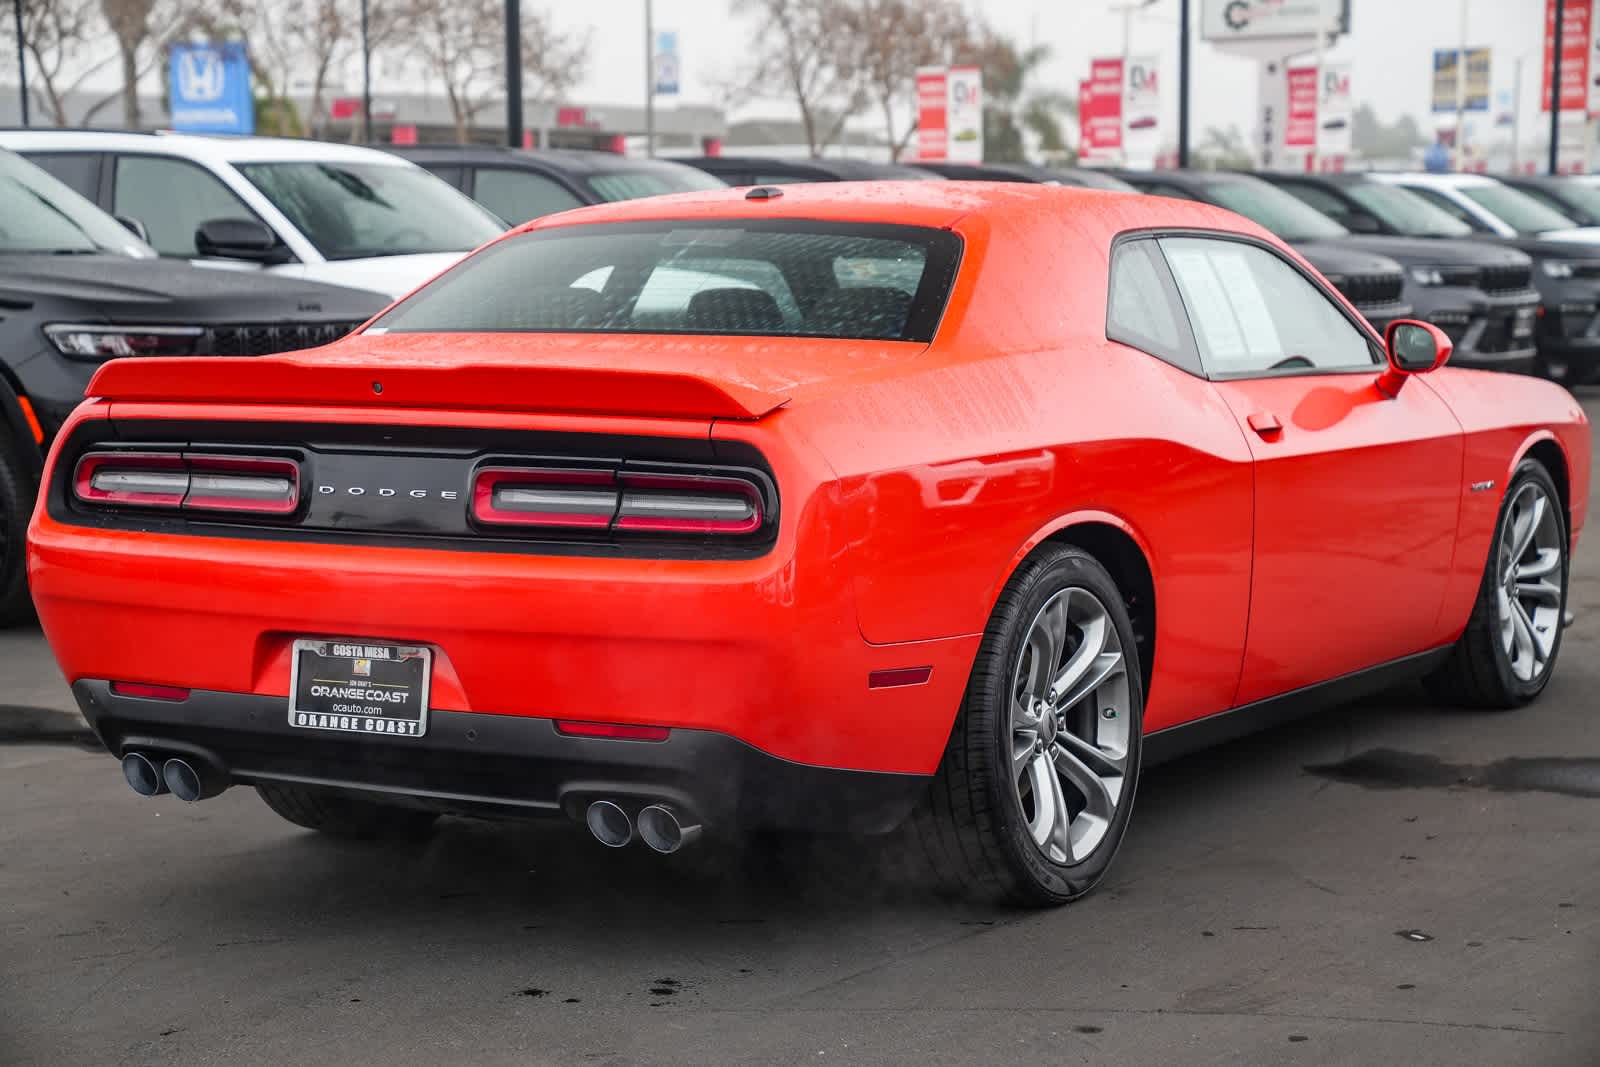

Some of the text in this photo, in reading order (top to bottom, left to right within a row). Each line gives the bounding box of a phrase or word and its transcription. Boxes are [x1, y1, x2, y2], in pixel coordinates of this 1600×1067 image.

[319, 485, 457, 500] DODGE
[333, 644, 390, 659] COSTA MESA
[332, 703, 383, 715] ocauto.com
[298, 713, 416, 734] ORANGE COAST
